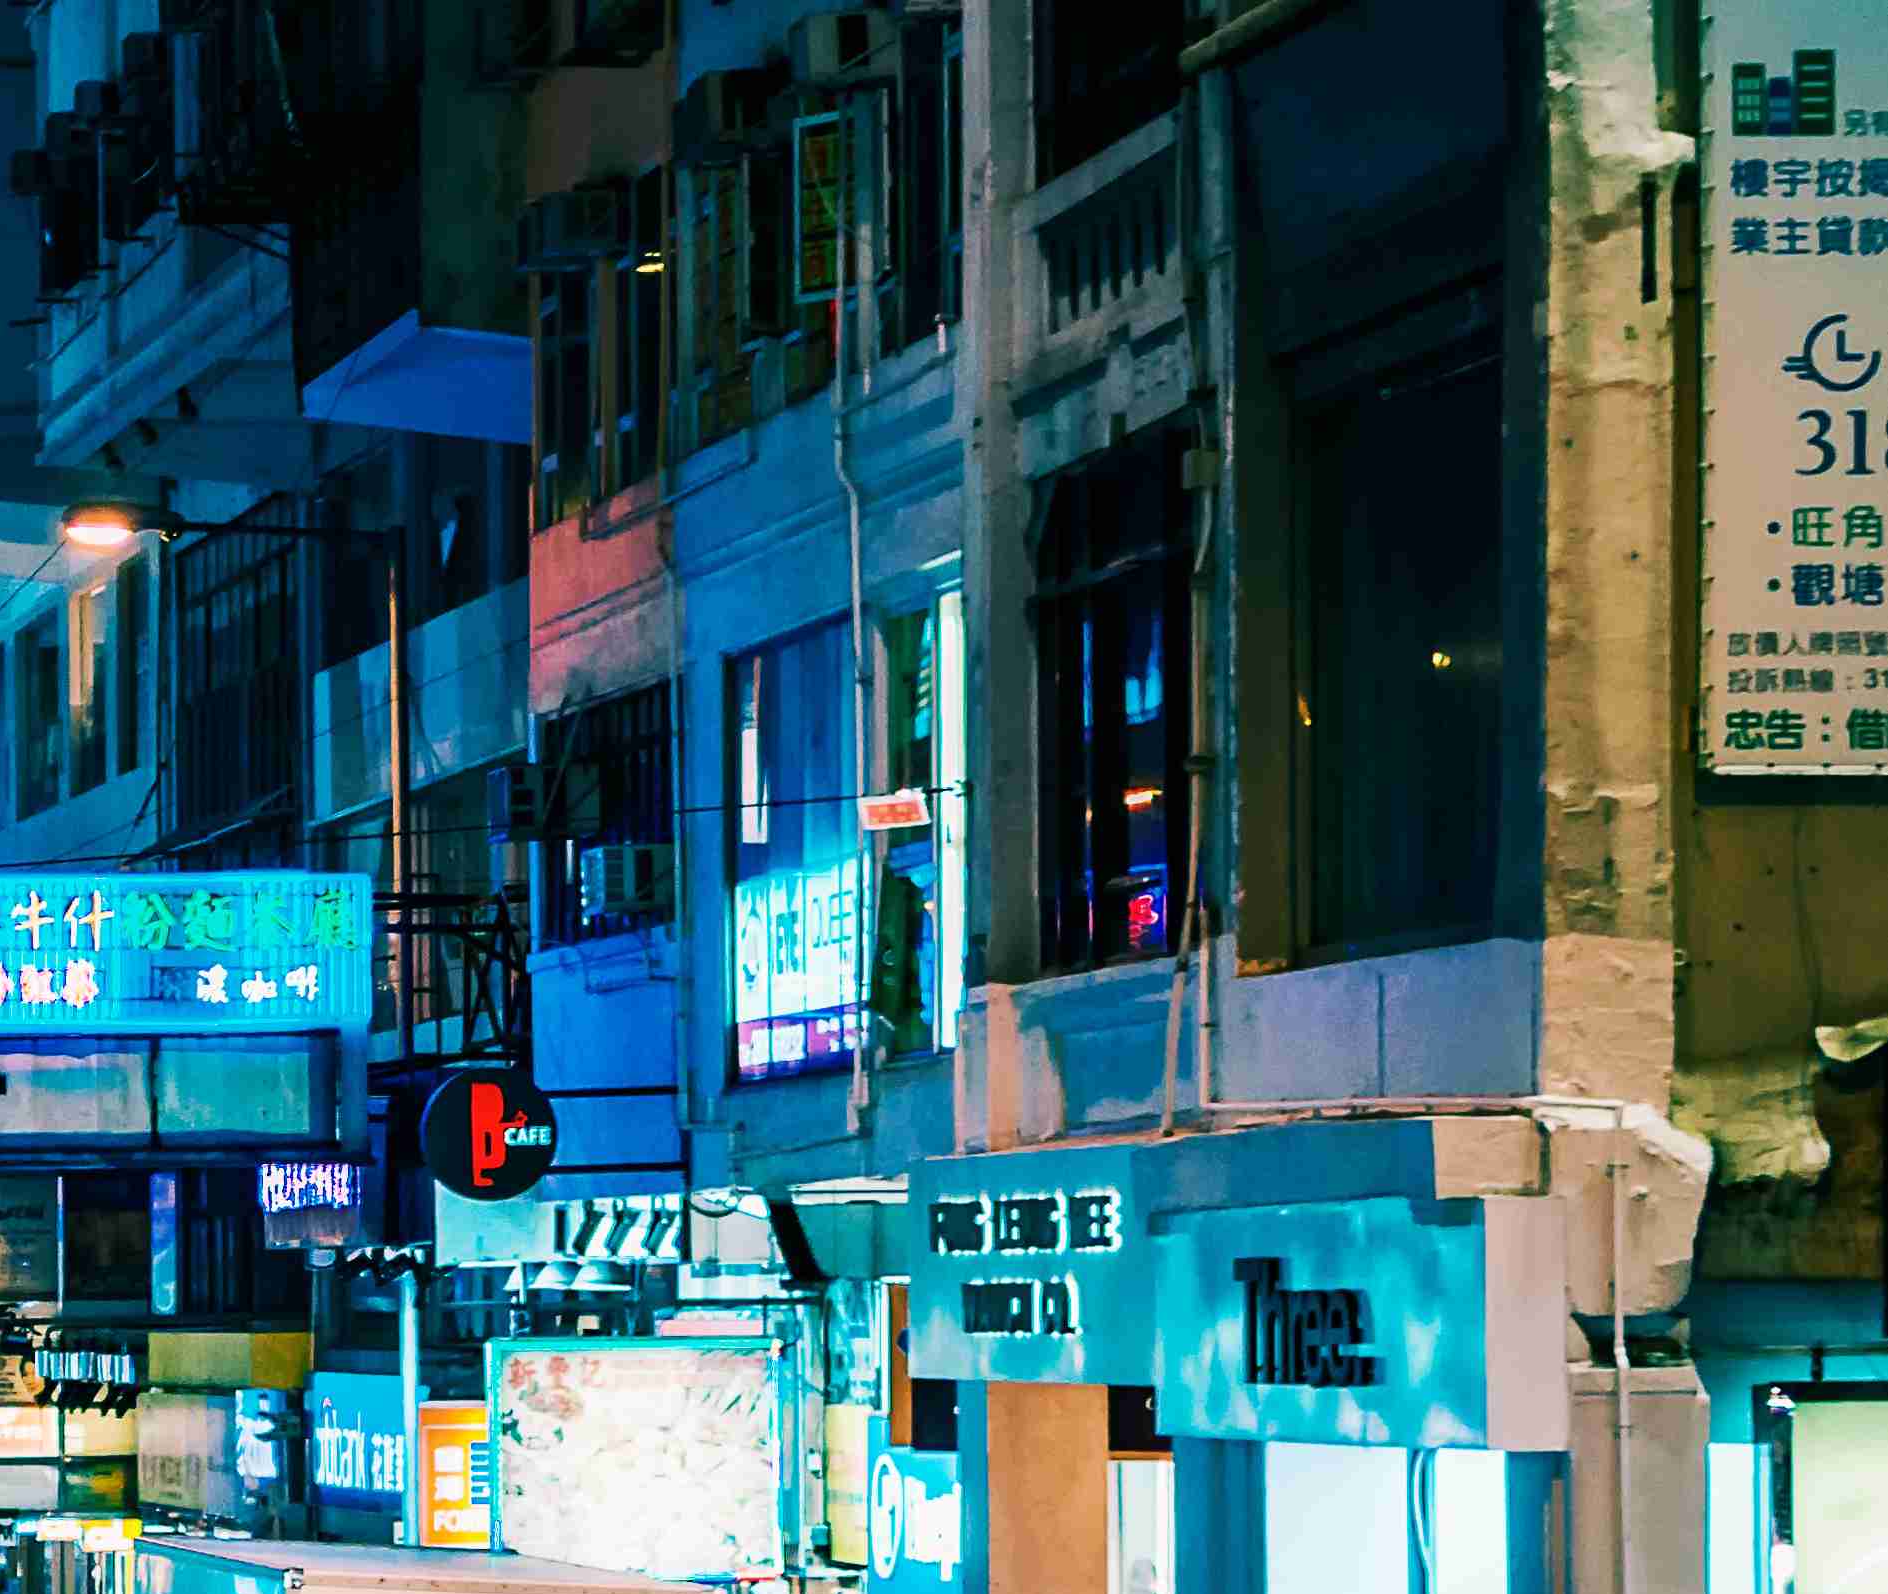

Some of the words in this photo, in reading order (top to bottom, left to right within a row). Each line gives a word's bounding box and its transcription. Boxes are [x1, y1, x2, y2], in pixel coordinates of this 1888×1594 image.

[1793, 408, 1888, 477] 31
[1792, 506, 1884, 549] 旺角
[1791, 563, 1885, 606] 觀塘
[504, 1126, 551, 1147] CAFE
